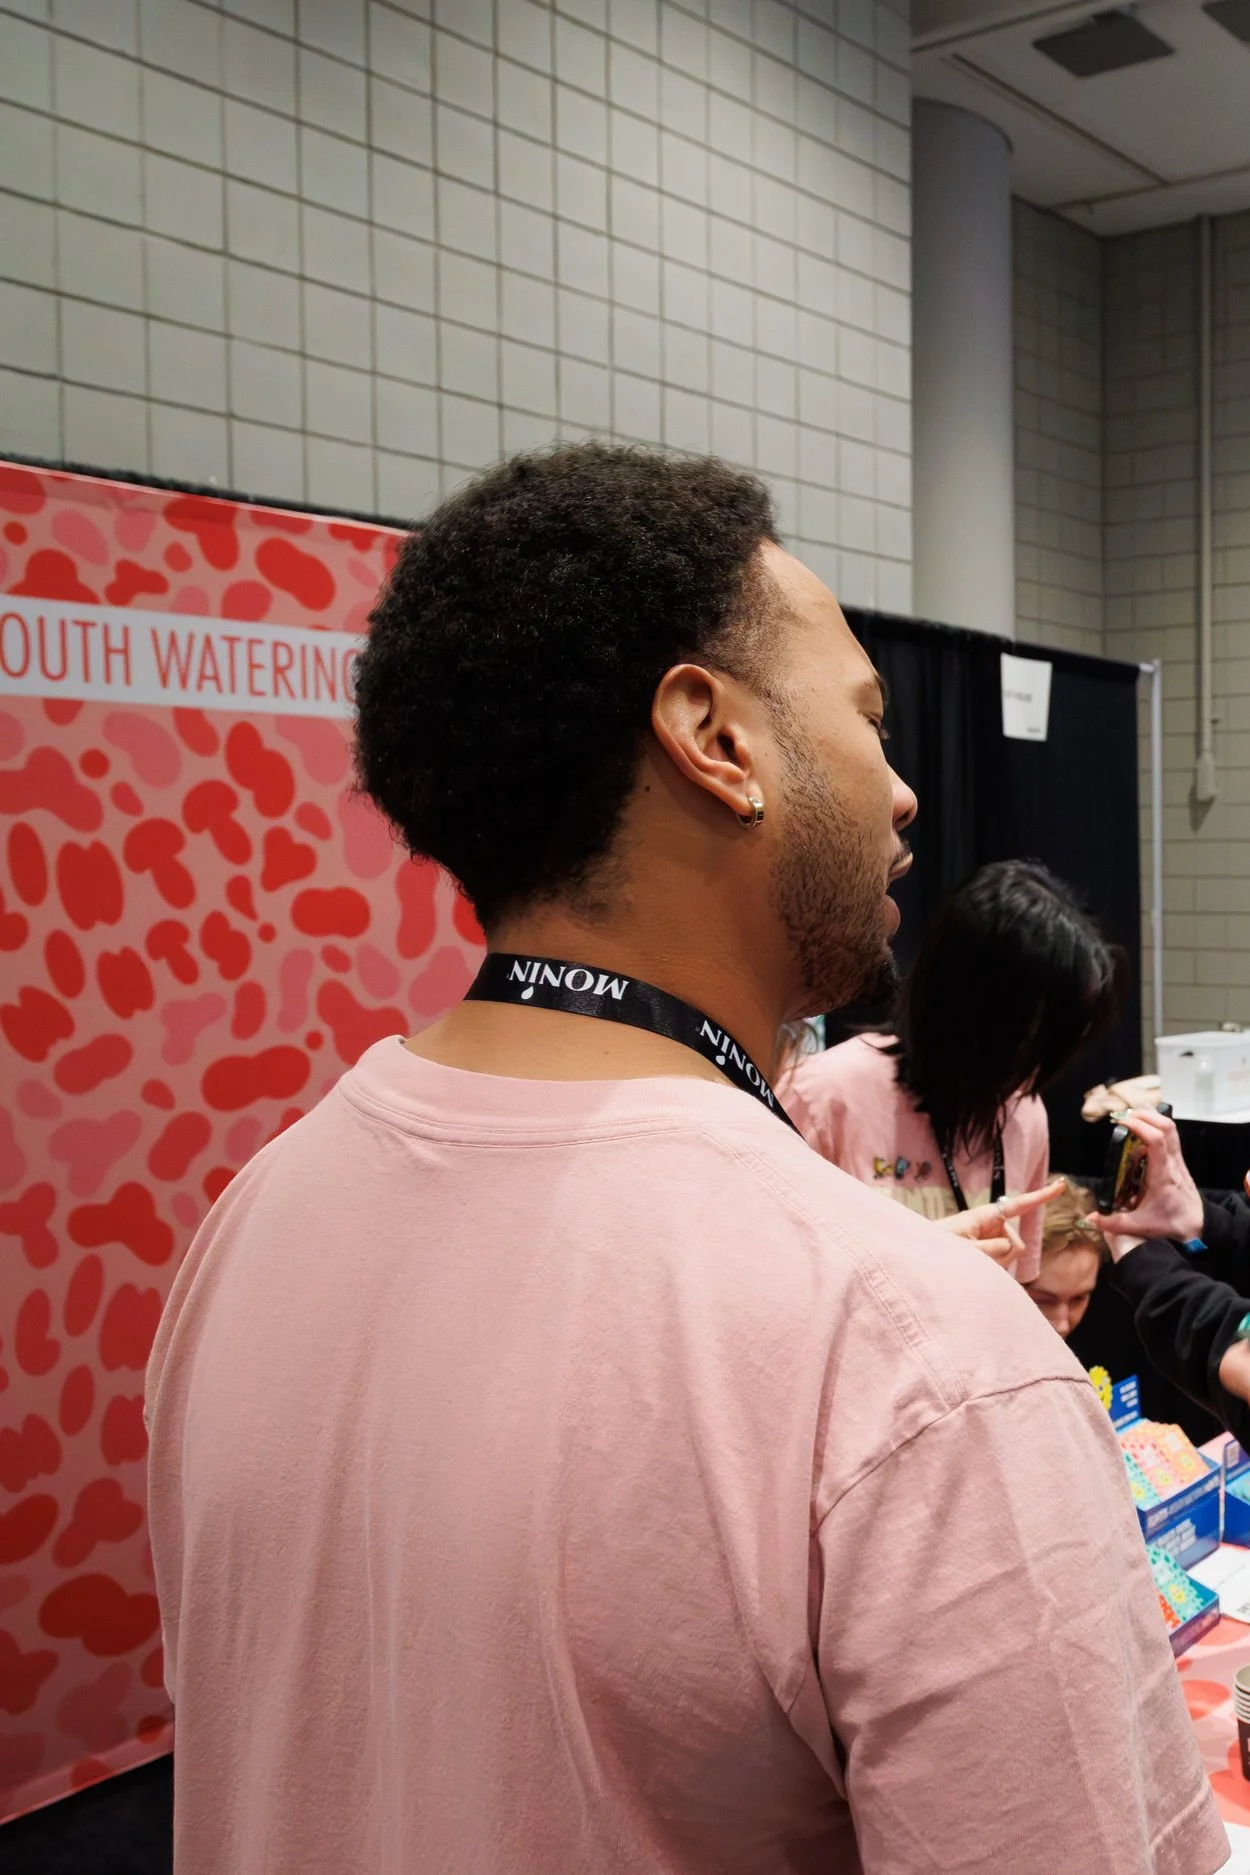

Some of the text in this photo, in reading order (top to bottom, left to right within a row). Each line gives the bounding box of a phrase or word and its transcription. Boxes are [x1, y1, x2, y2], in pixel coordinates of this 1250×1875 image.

[0, 611, 132, 687] OUTH
[509, 960, 629, 1000] MONIN
[700, 1020, 774, 1108] MONIN
